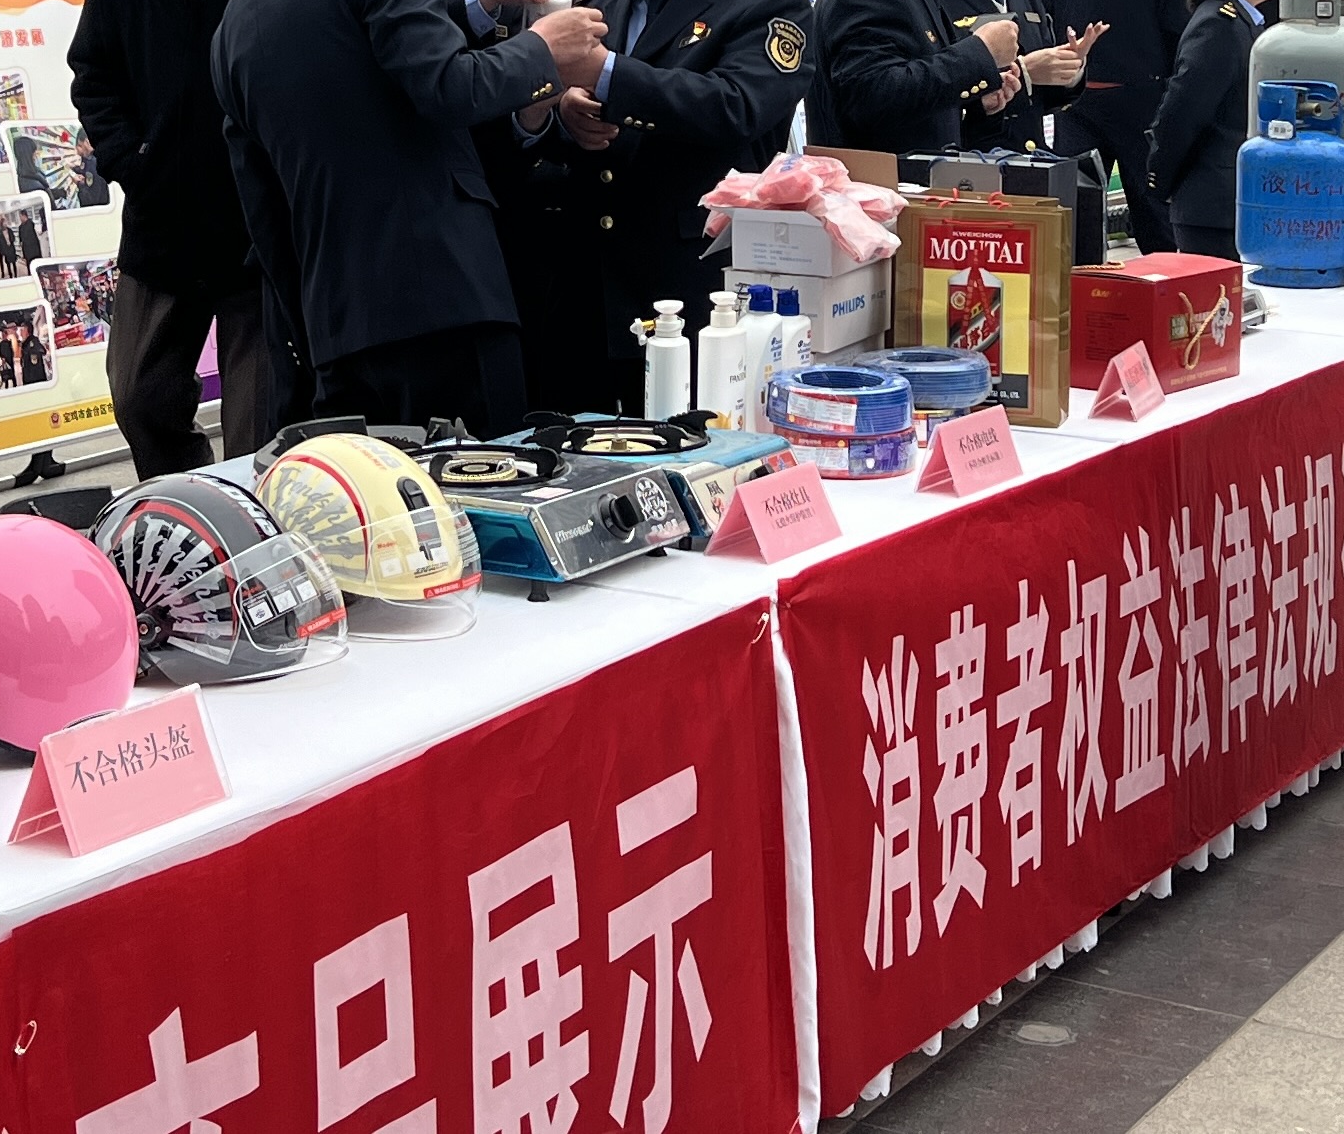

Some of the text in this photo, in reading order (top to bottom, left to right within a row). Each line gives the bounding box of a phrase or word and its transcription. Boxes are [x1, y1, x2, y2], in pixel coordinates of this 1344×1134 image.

[952, 231, 1004, 239] KWEICHOW
[832, 294, 866, 318] PHILIPS
[70, 721, 195, 797] 不合格头盔
